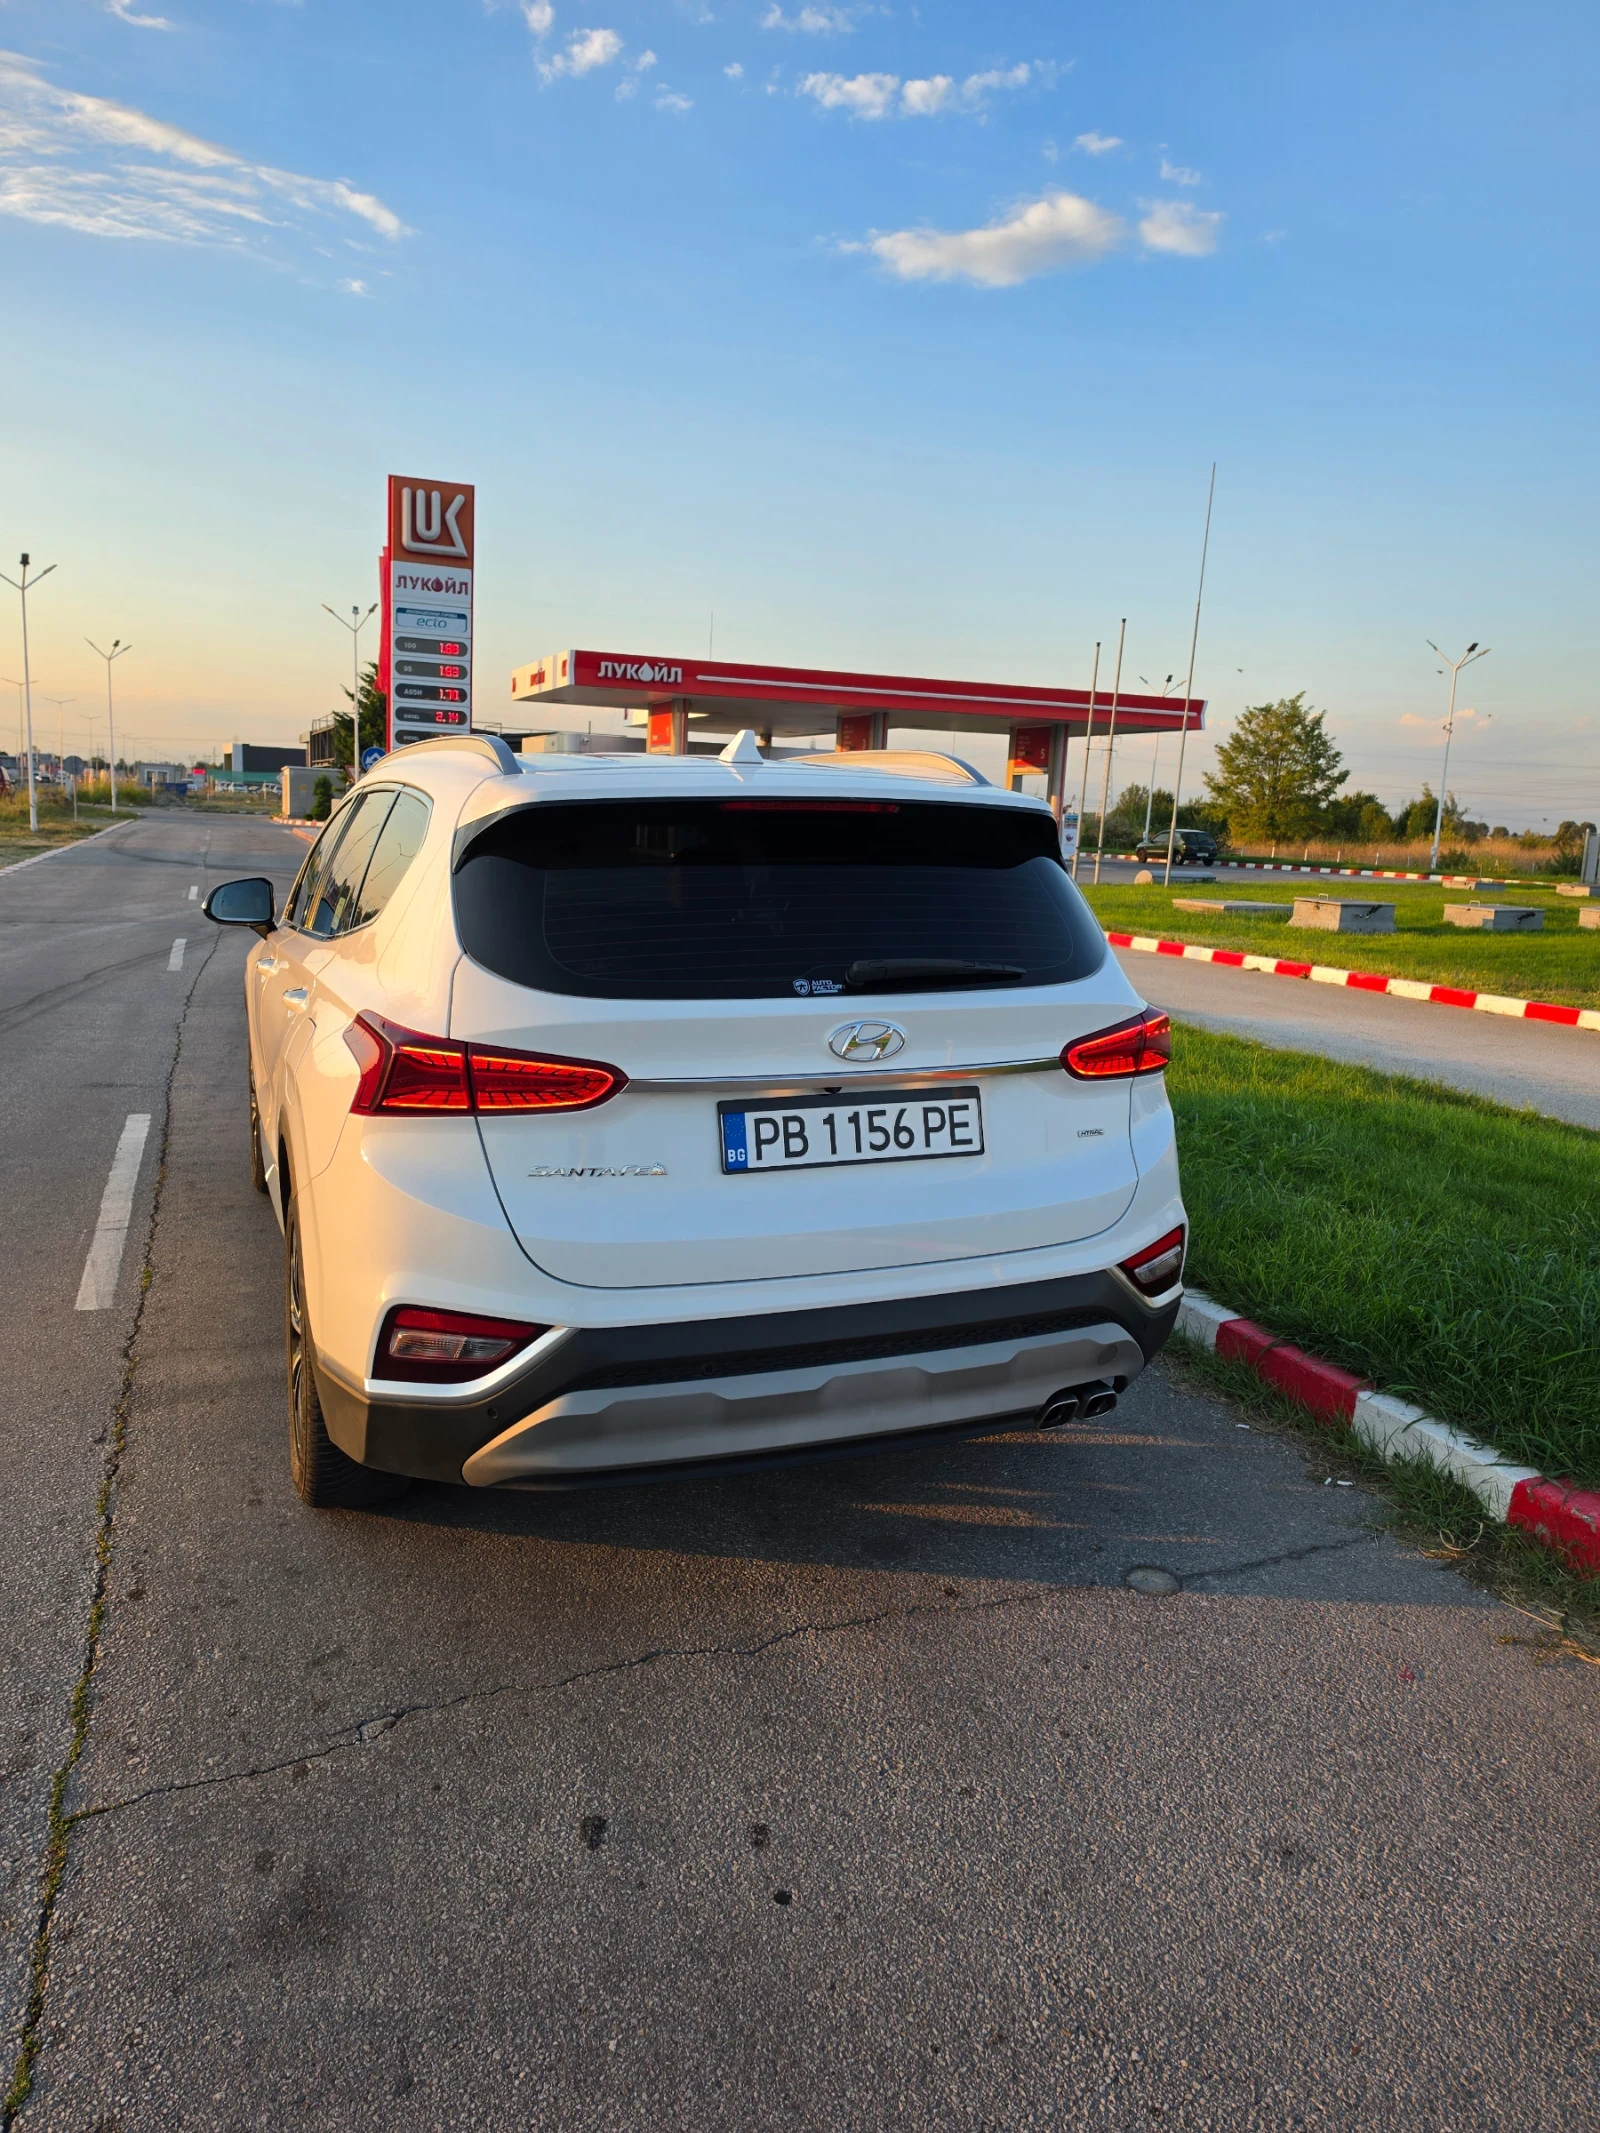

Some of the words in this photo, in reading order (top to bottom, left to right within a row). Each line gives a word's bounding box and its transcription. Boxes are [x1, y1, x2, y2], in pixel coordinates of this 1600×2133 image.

[401, 487, 468, 558] LUK
[395, 574, 469, 595] ЛУКОЙЛ
[416, 617, 448, 629] ecto
[597, 661, 683, 683] ЛУКОЙЛ
[1040, 748, 1046, 760] 5
[754, 1115, 810, 1161] PB
[822, 1108, 915, 1155] 1156
[922, 1104, 973, 1148] PE
[1080, 1128, 1104, 1137] HTRAC
[727, 1148, 746, 1163] BG
